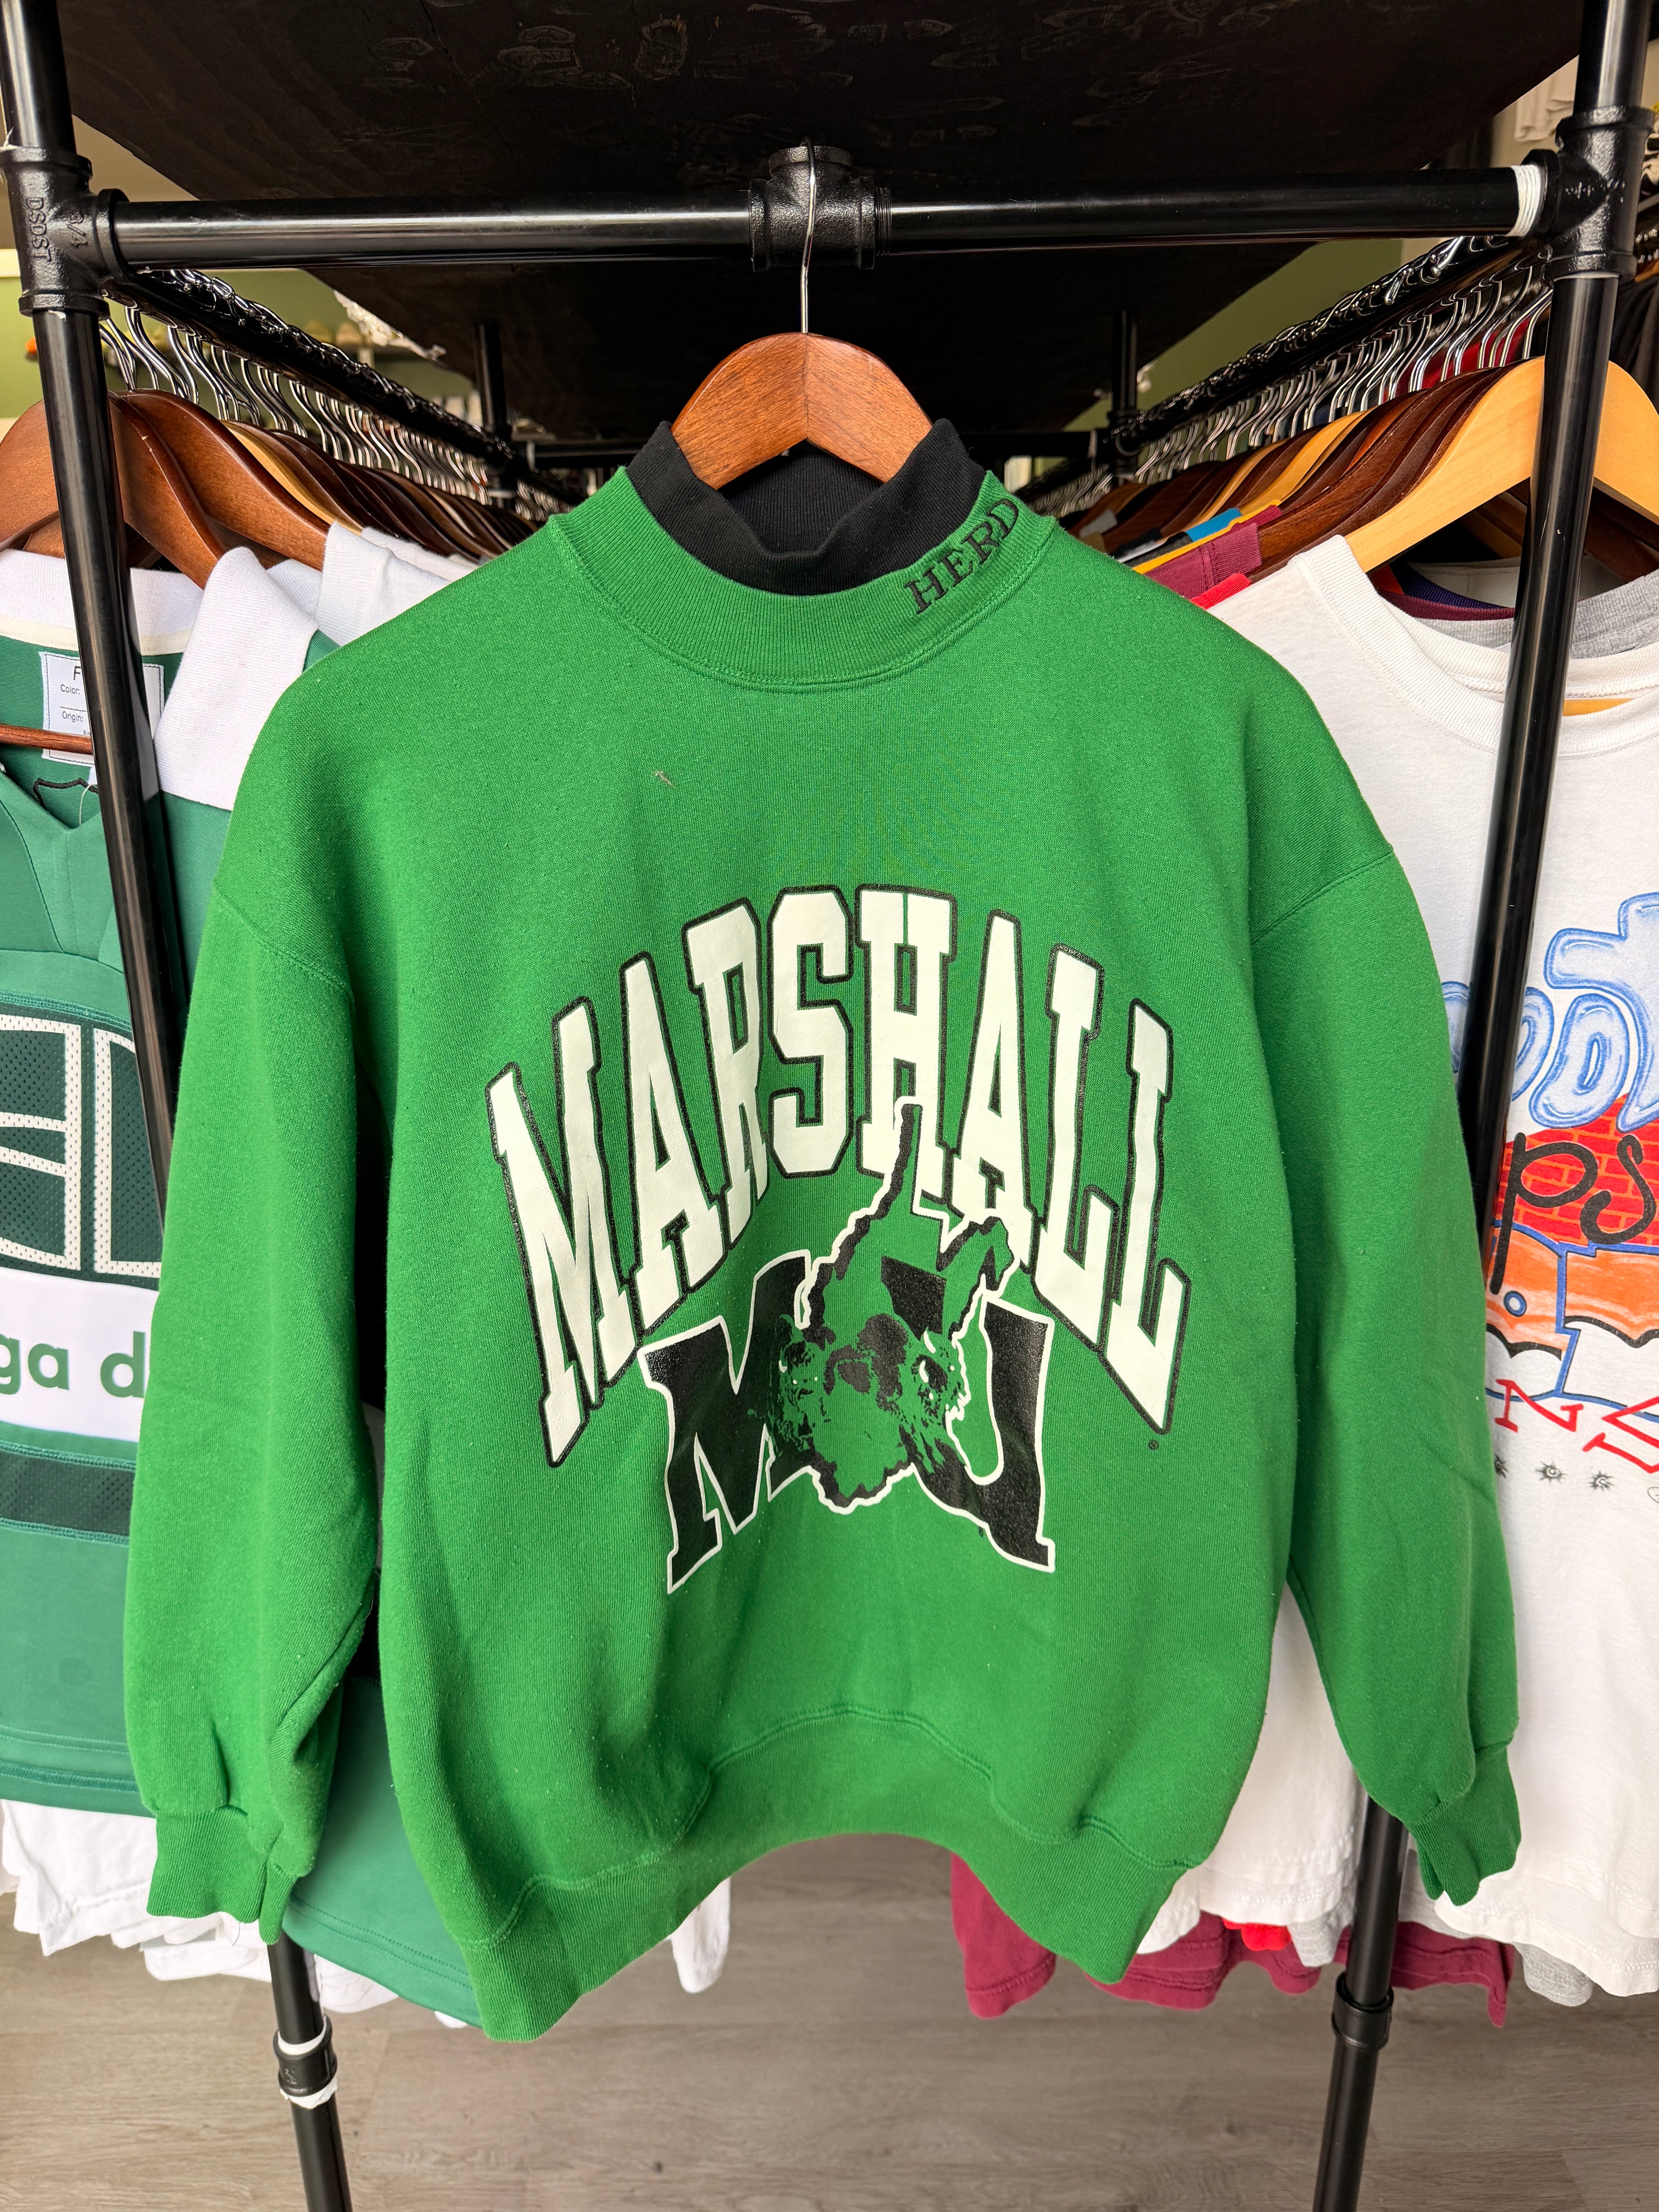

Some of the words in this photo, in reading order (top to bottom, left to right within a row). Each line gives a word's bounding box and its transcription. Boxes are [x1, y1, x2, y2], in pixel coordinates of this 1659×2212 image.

[26, 197, 51, 262] DSDST
[67, 211, 88, 248] 3/4
[904, 498, 1018, 614] HERD
[60, 684, 80, 695] Color:
[62, 711, 83, 723] Origin:
[485, 884, 1191, 1467] MARSHALL
